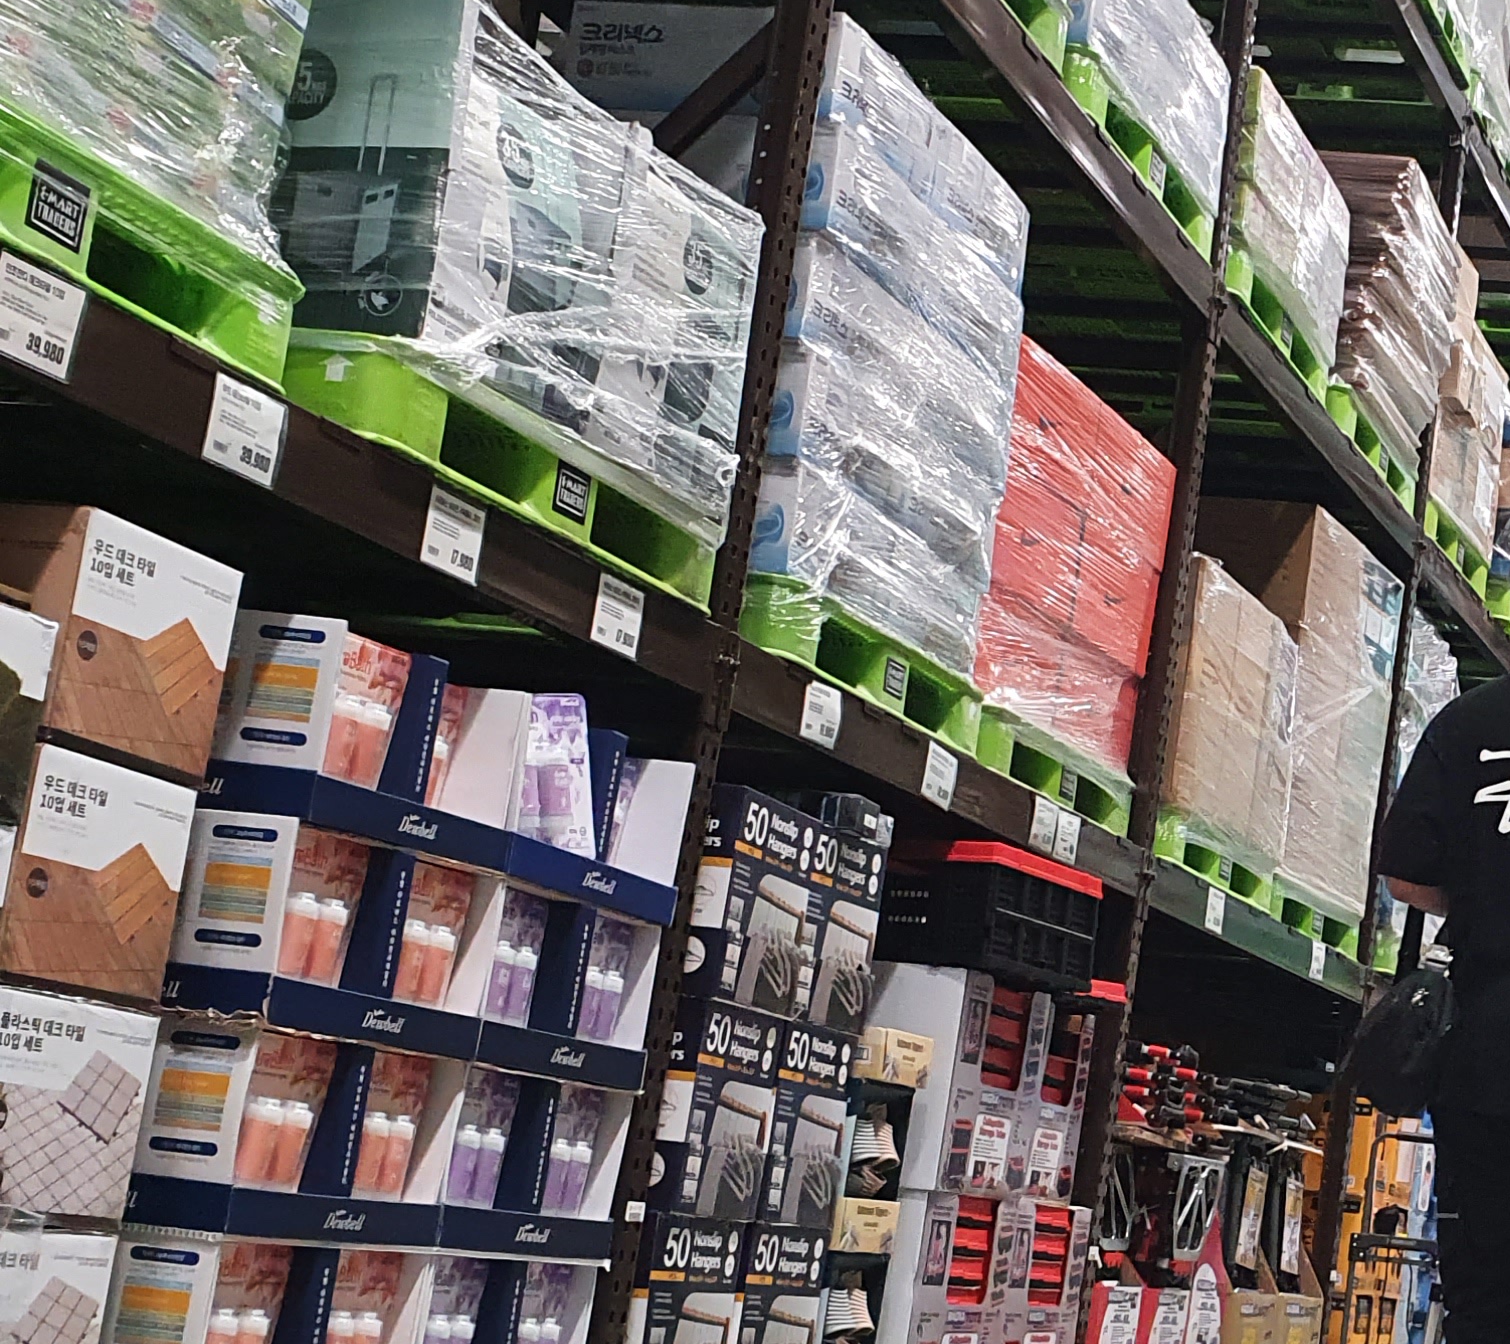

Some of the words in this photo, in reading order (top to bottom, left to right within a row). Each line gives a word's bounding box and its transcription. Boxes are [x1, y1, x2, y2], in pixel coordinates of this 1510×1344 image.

[579, 22, 665, 44] 크리넥스
[25, 332, 65, 365] 39,980
[93, 538, 115, 561] 우드
[115, 548, 136, 568] 데크
[136, 557, 158, 578] 타일
[115, 566, 136, 588] 세트
[43, 774, 65, 795] 우드
[65, 782, 88, 801] 데크
[65, 800, 87, 820] 세트
[744, 801, 769, 846] 50
[397, 812, 439, 839] Dewbell
[813, 833, 839, 874] 50
[43, 1020, 64, 1037] 데크
[361, 1009, 406, 1035] Dewbell
[705, 1012, 732, 1055] 50
[23, 1035, 44, 1053] 세트
[786, 1030, 810, 1071] 50
[663, 1227, 692, 1269] 50
[754, 1233, 780, 1273] 50
